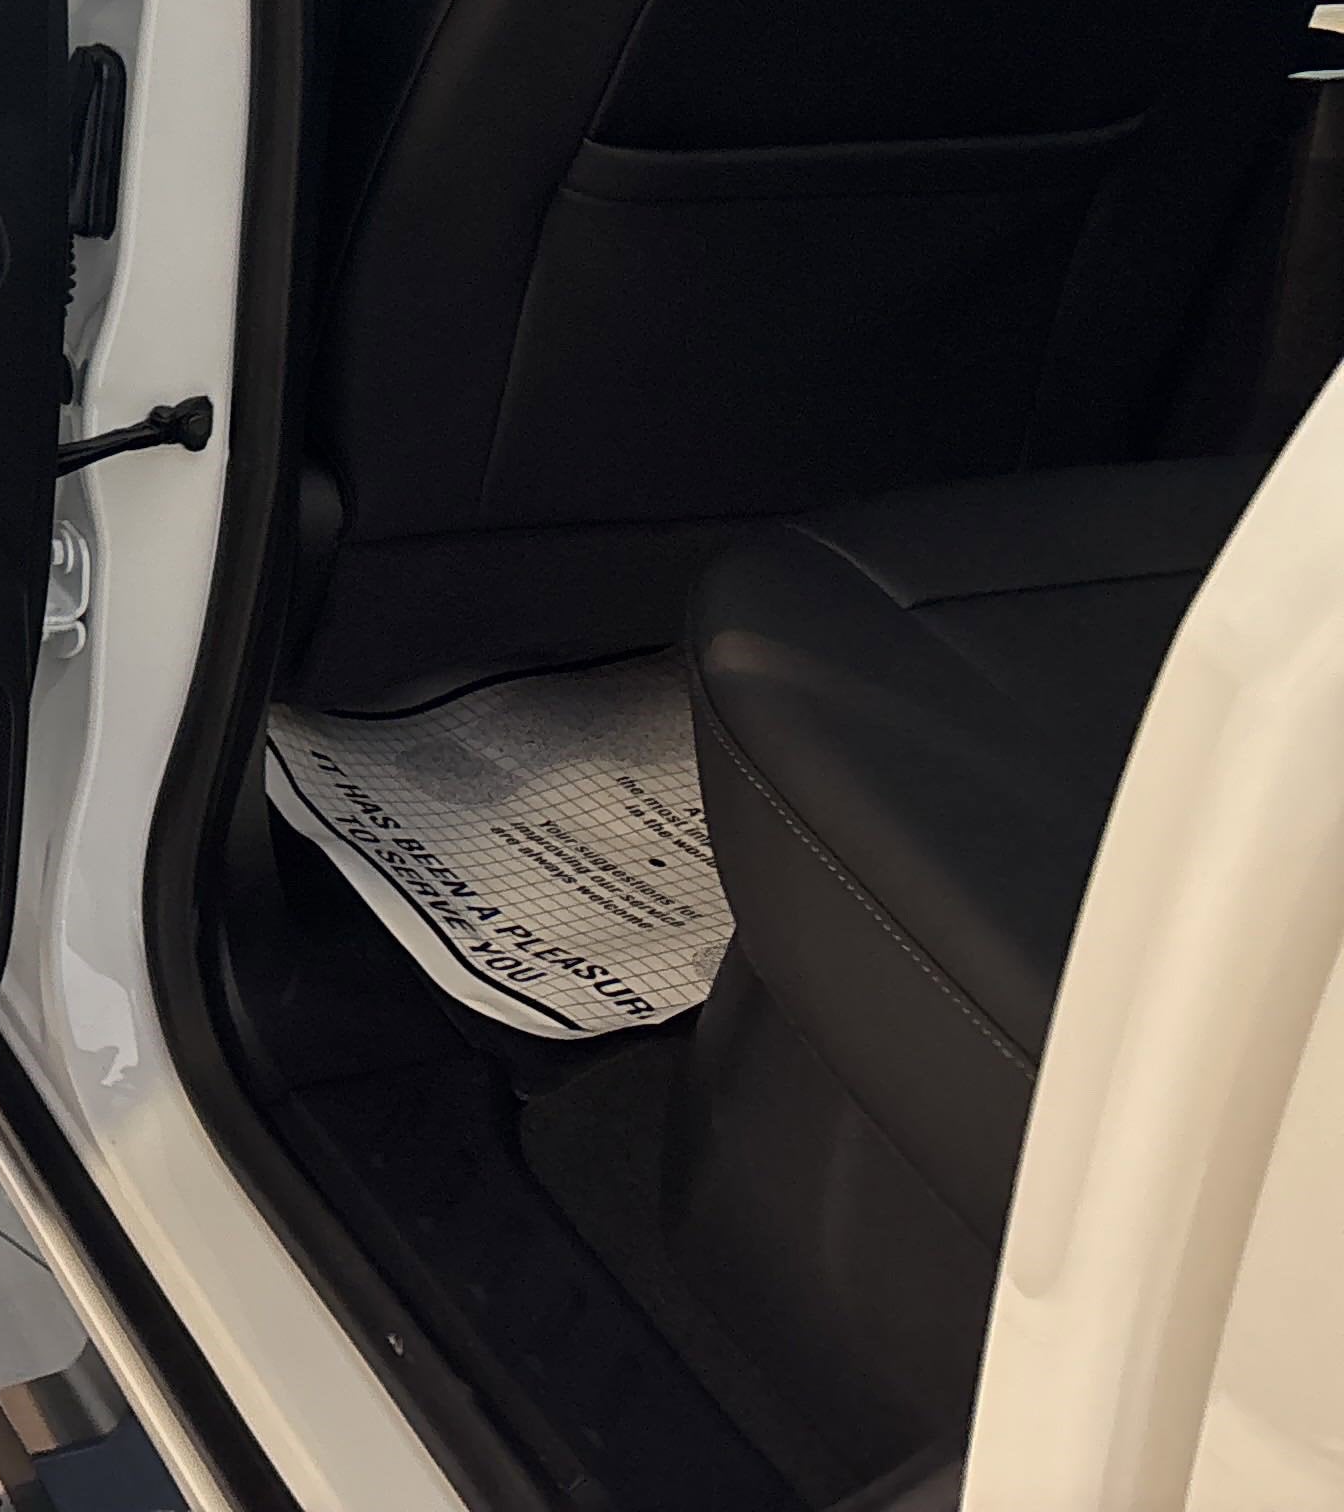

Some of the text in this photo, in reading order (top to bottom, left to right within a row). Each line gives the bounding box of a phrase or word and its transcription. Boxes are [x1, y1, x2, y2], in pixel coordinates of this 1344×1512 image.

[312, 750, 347, 777] IT
[335, 782, 403, 831] HAS
[392, 838, 478, 900] BEEN
[468, 904, 504, 923] A
[616, 775, 645, 796] the
[643, 796, 688, 828] most
[624, 804, 646, 818] in
[642, 819, 673, 839] the
[335, 814, 548, 984] TO SERVE YOU
[489, 826, 521, 846] are
[518, 846, 579, 885] always
[512, 821, 688, 929] improving our service
[537, 820, 704, 920] Your suggestions for
